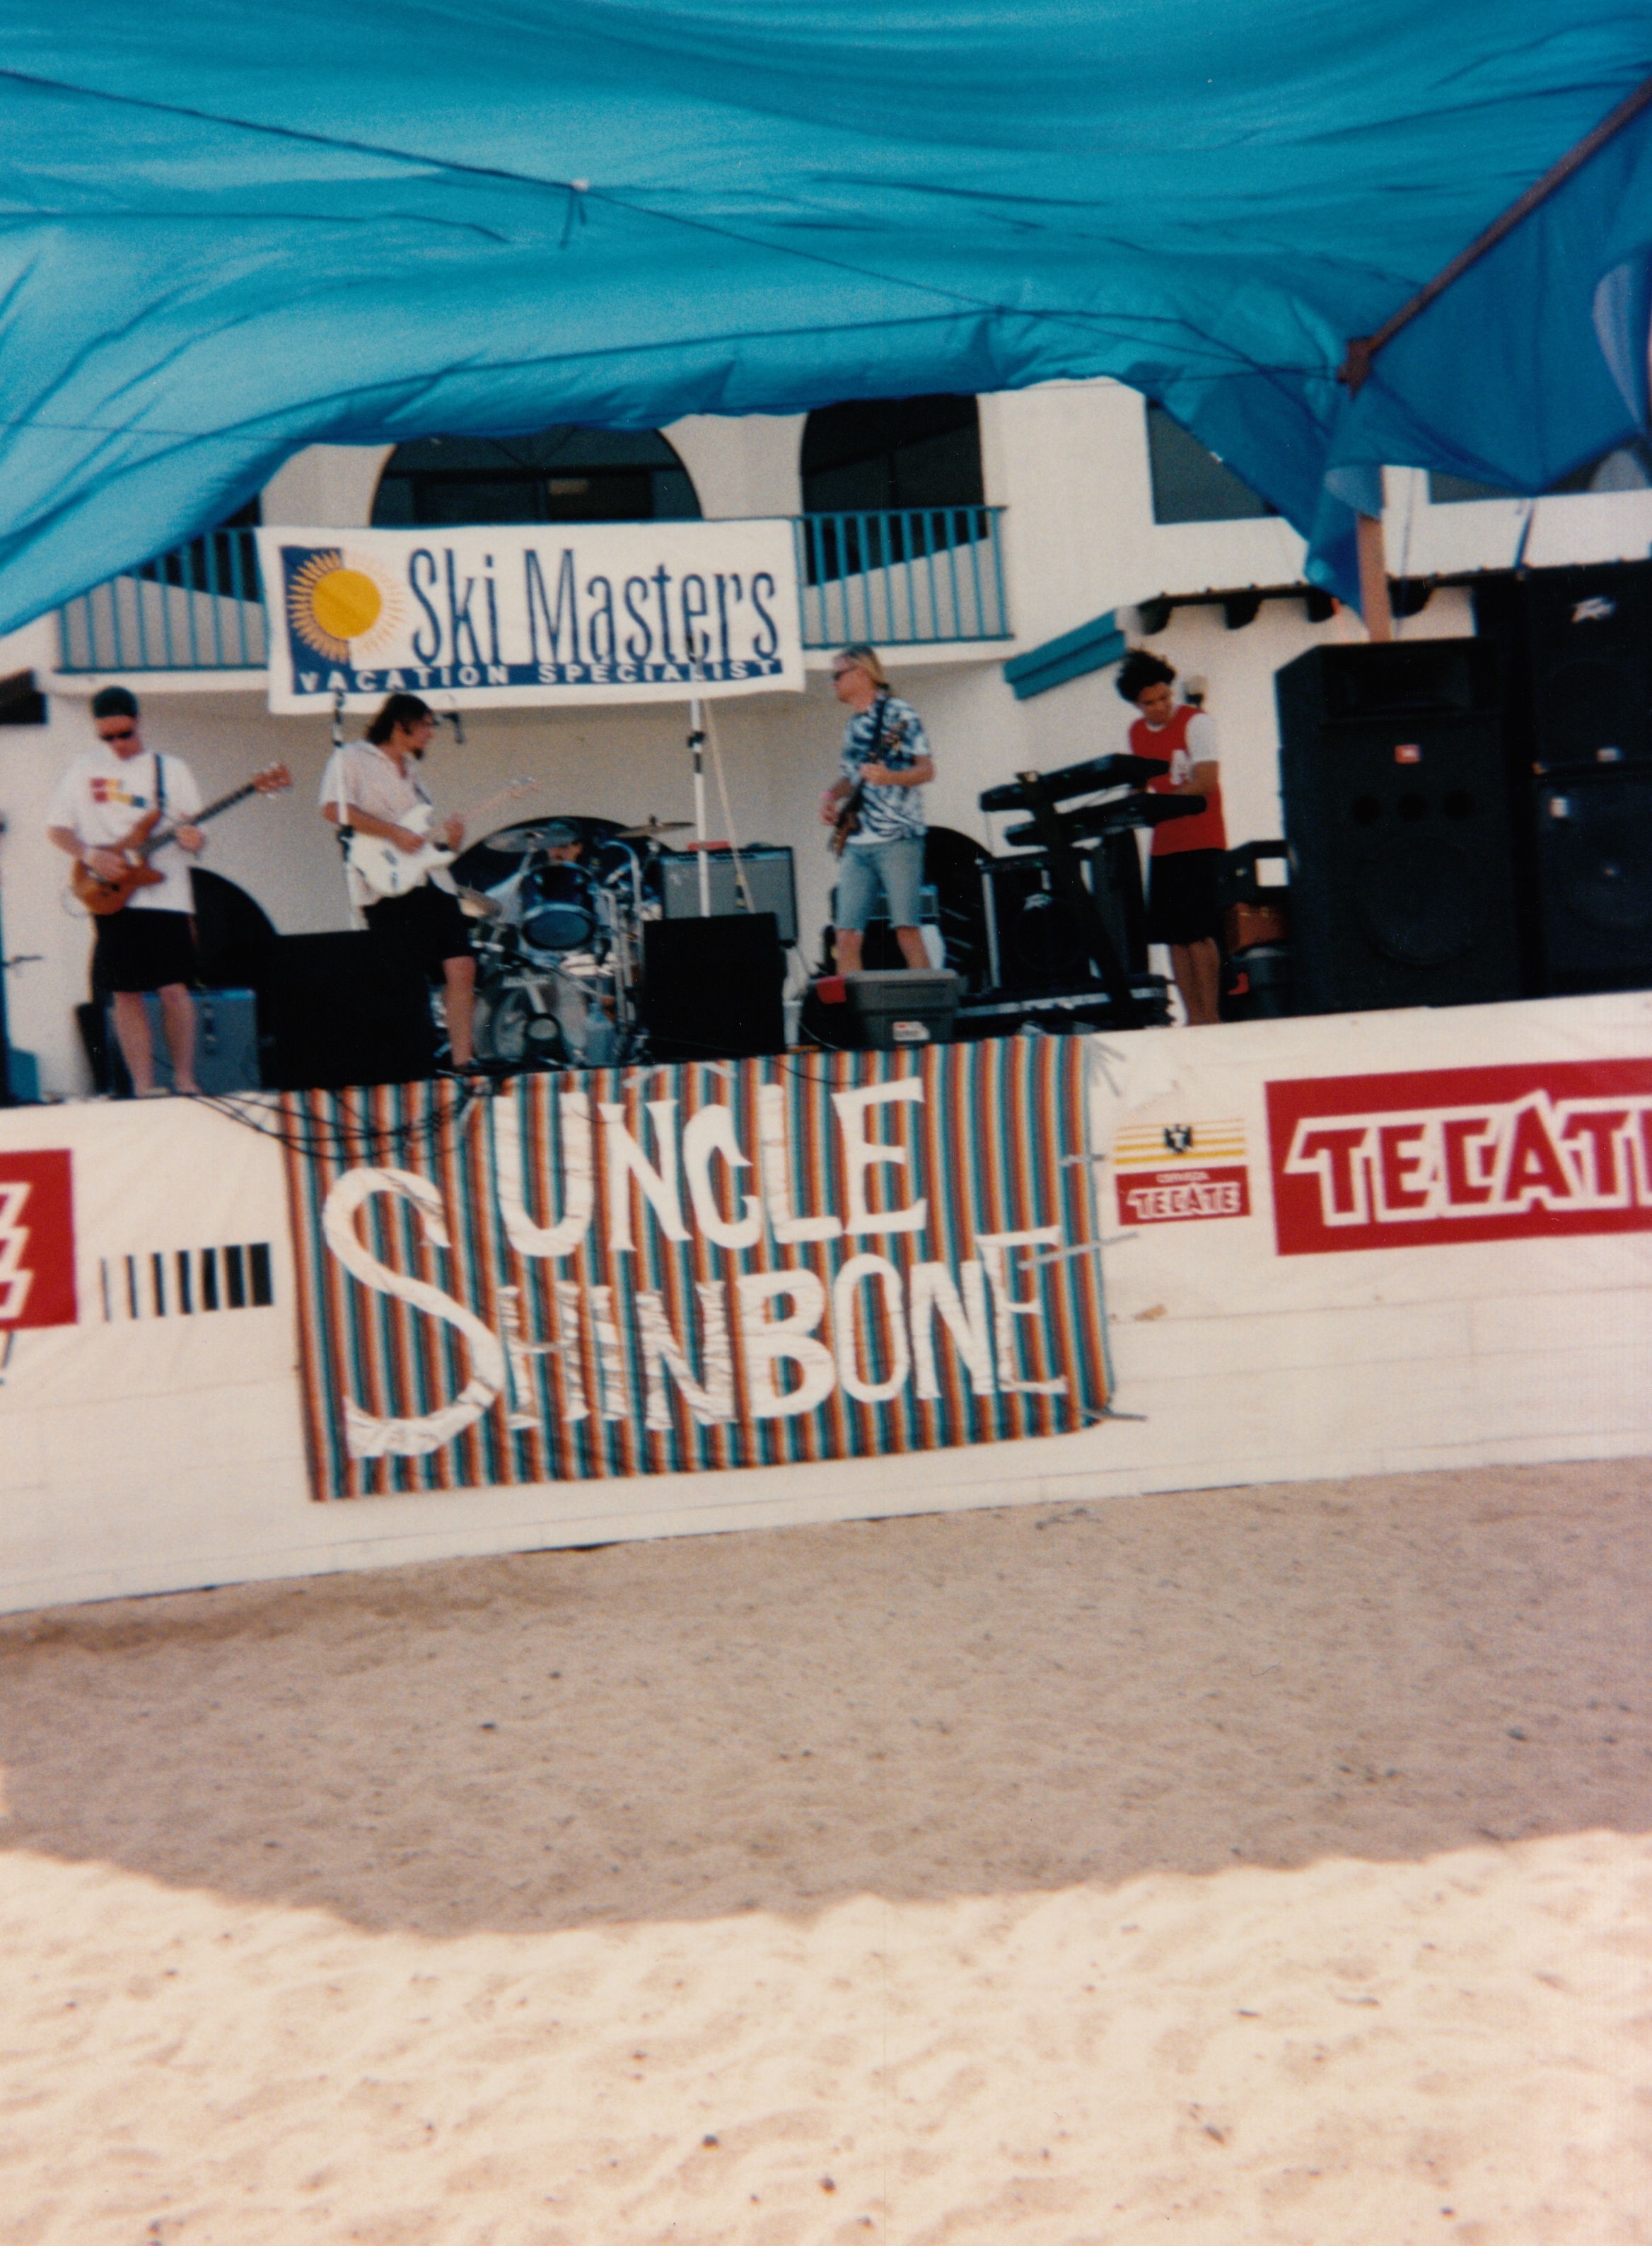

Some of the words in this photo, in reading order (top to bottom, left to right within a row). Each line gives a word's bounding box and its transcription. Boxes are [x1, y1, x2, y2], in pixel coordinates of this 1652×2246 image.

[409, 548, 503, 665] Ski
[524, 548, 778, 665] Masters
[299, 665, 510, 692] VACATION
[537, 659, 774, 684] SPECIALIST
[493, 1078, 927, 1257] UNCLE
[1127, 1182, 1241, 1220] TECATE
[1284, 1090, 1652, 1227] TECAT
[322, 1167, 1067, 1458] SHINBONE
